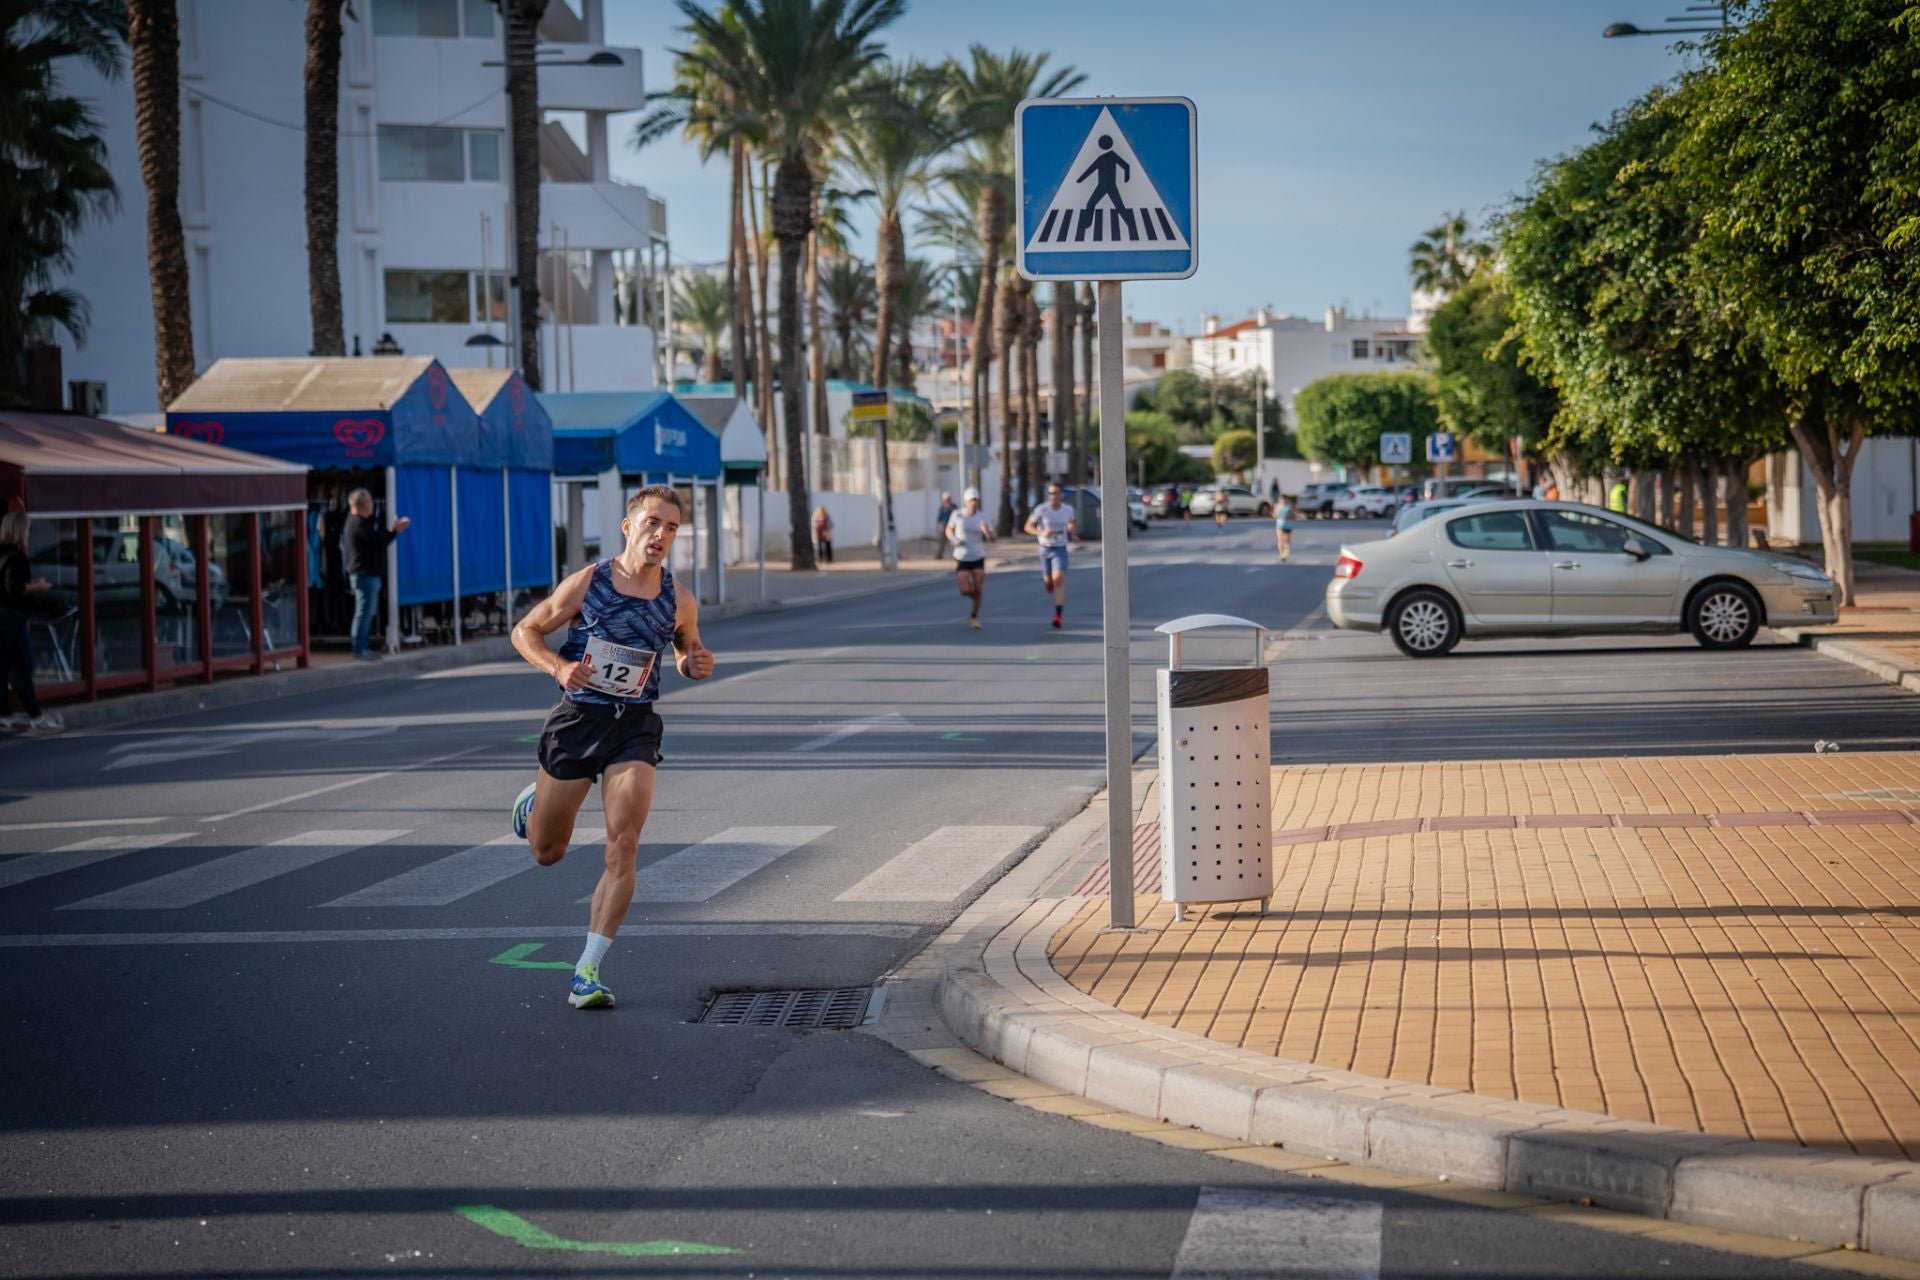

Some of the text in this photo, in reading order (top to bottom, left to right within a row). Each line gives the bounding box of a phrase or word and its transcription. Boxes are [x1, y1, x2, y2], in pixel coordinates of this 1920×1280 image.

[1435, 432, 1449, 450] P
[609, 645, 634, 658] MEDIA
[602, 662, 630, 683] 12
